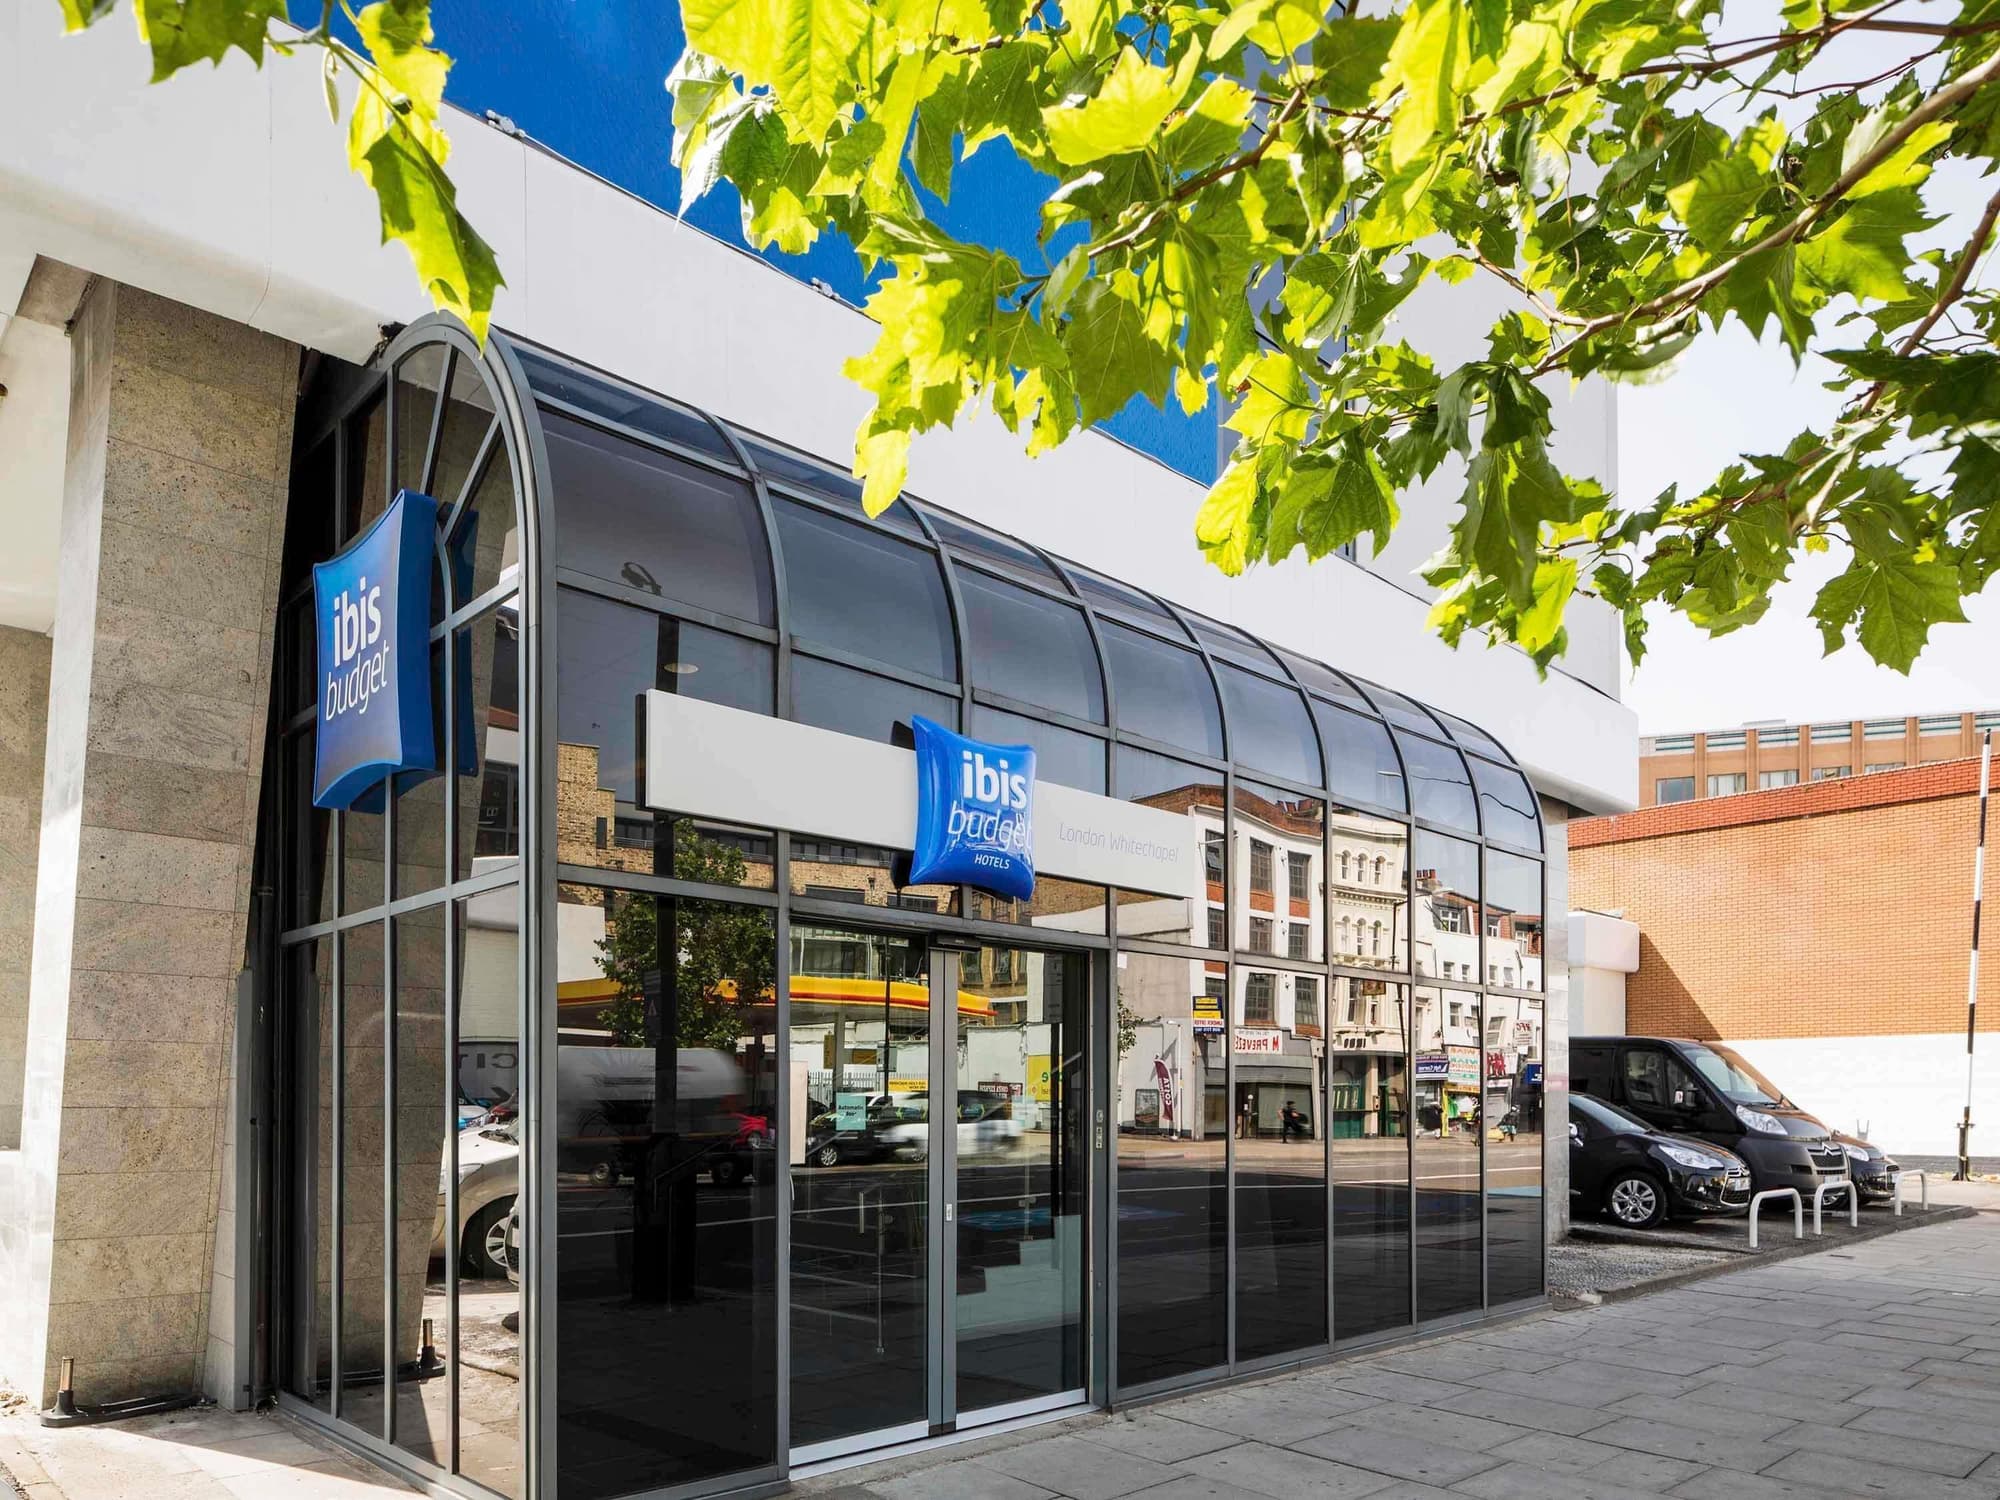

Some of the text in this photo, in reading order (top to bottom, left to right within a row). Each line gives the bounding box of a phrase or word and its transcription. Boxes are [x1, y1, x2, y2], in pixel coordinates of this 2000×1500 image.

[334, 576, 382, 666] ibis
[326, 640, 389, 721] budget
[962, 751, 1027, 809] ibis
[948, 800, 1032, 851] budget
[1059, 823, 1179, 863] London Whitechapel
[974, 853, 1010, 870] HOTELS
